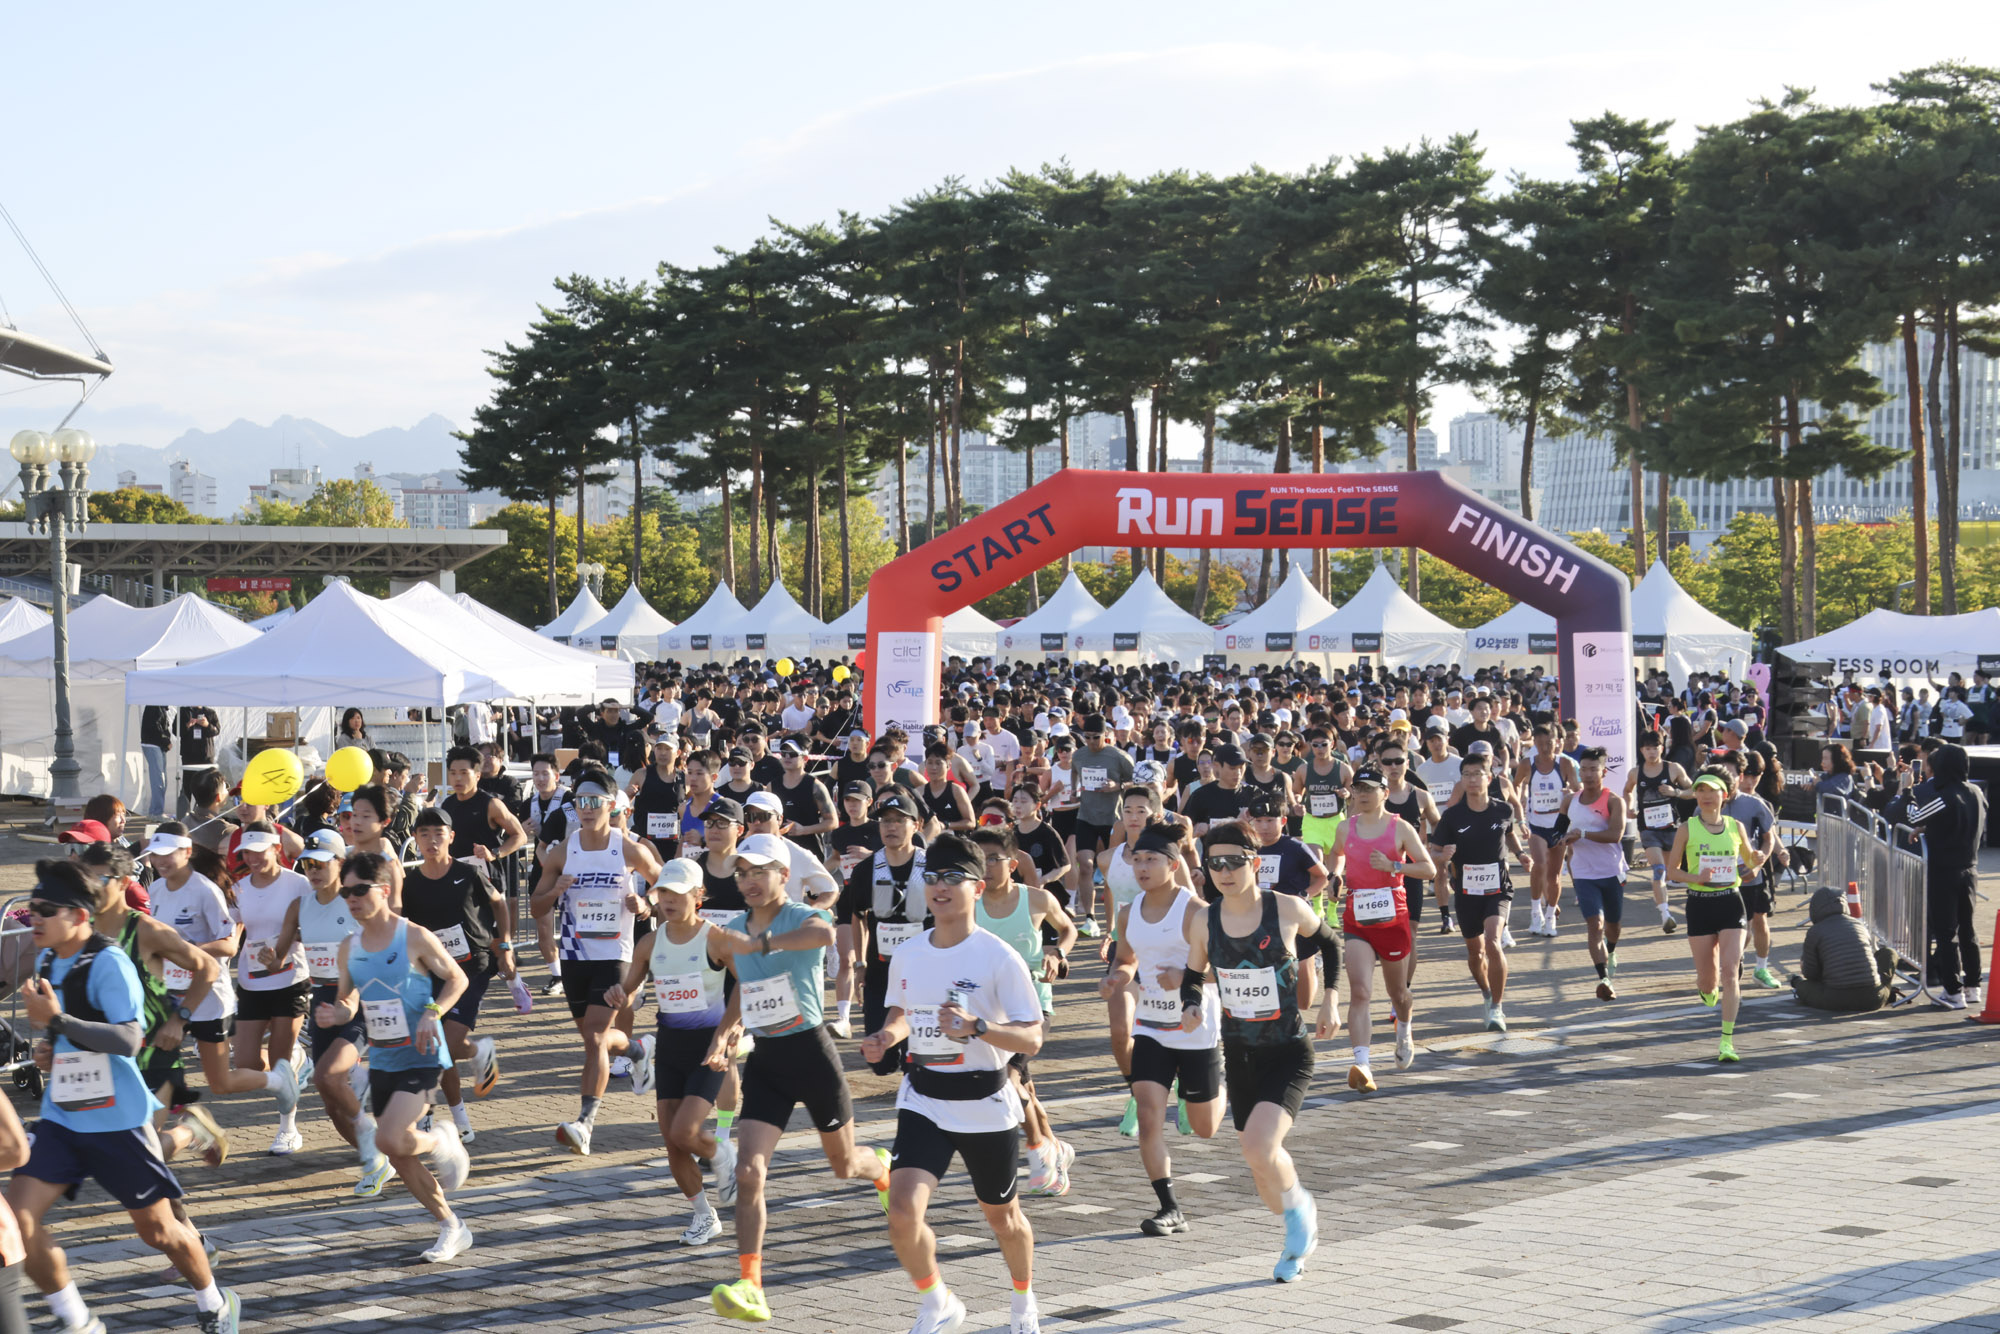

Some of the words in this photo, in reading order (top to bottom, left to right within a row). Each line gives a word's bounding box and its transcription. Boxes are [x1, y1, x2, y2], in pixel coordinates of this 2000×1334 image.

[1270, 486, 1287, 494] RUN
[1289, 486, 1304, 494] The
[1306, 486, 1336, 494] Record.
[1372, 485, 1399, 493] SENSE
[931, 503, 1056, 592] START
[1448, 503, 1581, 595] FINISH
[1828, 658, 1873, 674] RESS
[1592, 716, 1620, 727] Choco
[1588, 725, 1622, 736] Health
[1309, 784, 1330, 792] BEYOND
[1259, 866, 1274, 874] 553
[1712, 866, 1732, 874] 2176
[1700, 890, 1730, 898] DESCENTE
[1366, 900, 1389, 909] 1669
[591, 913, 616, 921] 1512
[442, 938, 460, 949] 048
[316, 957, 335, 966] 221
[668, 989, 698, 1001] 2500
[1235, 986, 1270, 998] 1450
[755, 996, 784, 1012] 1401
[1150, 1000, 1175, 1010] 1538
[917, 1026, 942, 1038] 105
